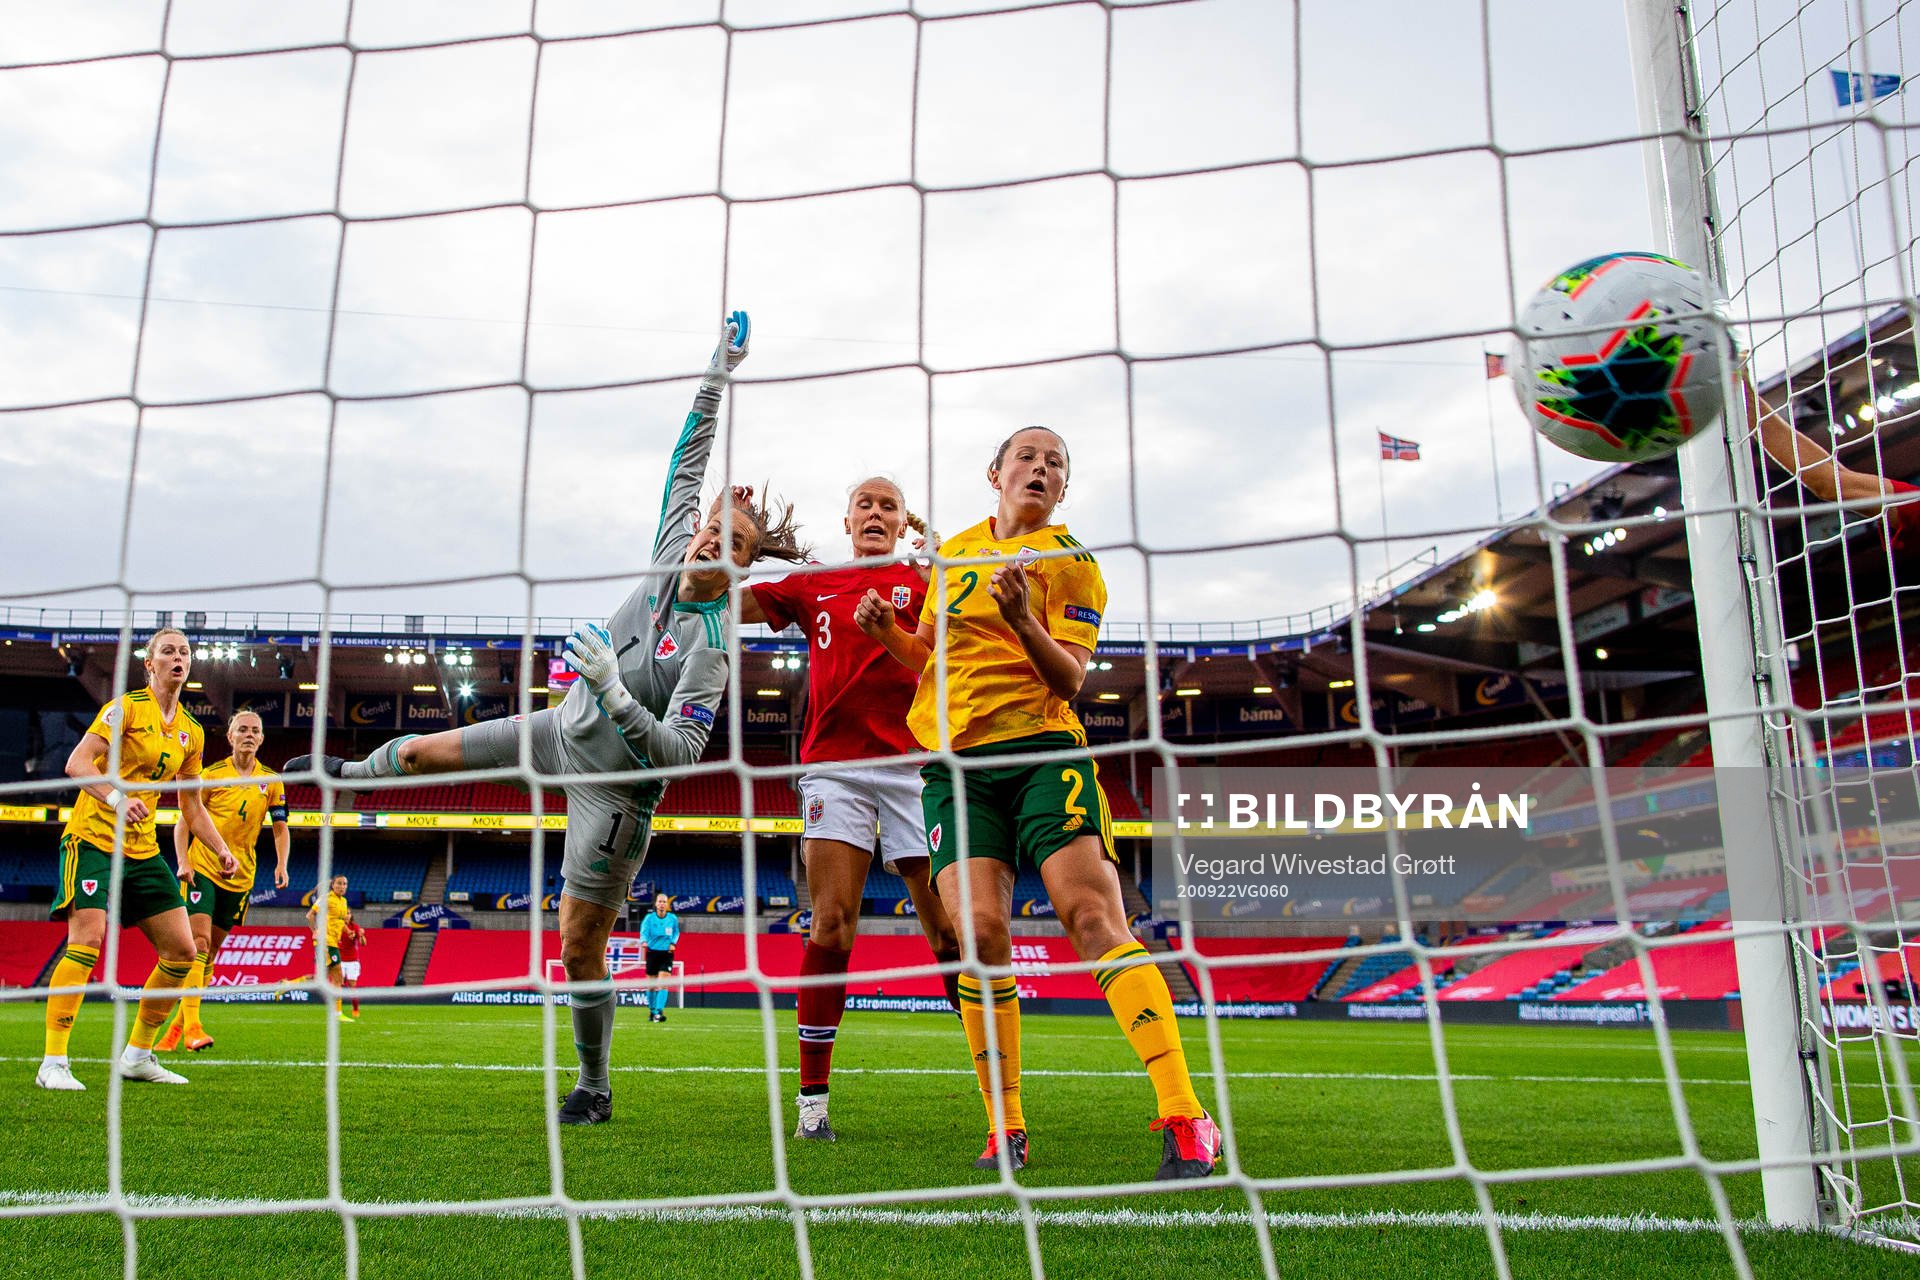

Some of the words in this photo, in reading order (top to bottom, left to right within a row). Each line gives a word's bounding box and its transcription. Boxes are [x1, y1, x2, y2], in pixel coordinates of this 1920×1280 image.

[948, 571, 979, 614] 2
[816, 611, 832, 650] 3
[747, 708, 788, 723] bama
[1084, 711, 1125, 727] bama
[1239, 706, 1284, 722] bama
[151, 751, 171, 780] 5
[1062, 768, 1088, 815] 2
[238, 799, 248, 822] 4
[406, 816, 438, 826] MOVE
[472, 816, 505, 826] MOVE
[652, 819, 675, 829] OVE
[708, 820, 741, 829] MOVE
[599, 811, 625, 856] 1
[672, 895, 702, 911] Bendit
[414, 905, 445, 922] Bendit
[220, 934, 307, 949] ERKERE
[452, 991, 483, 1004] Alltid
[485, 992, 511, 1004] med
